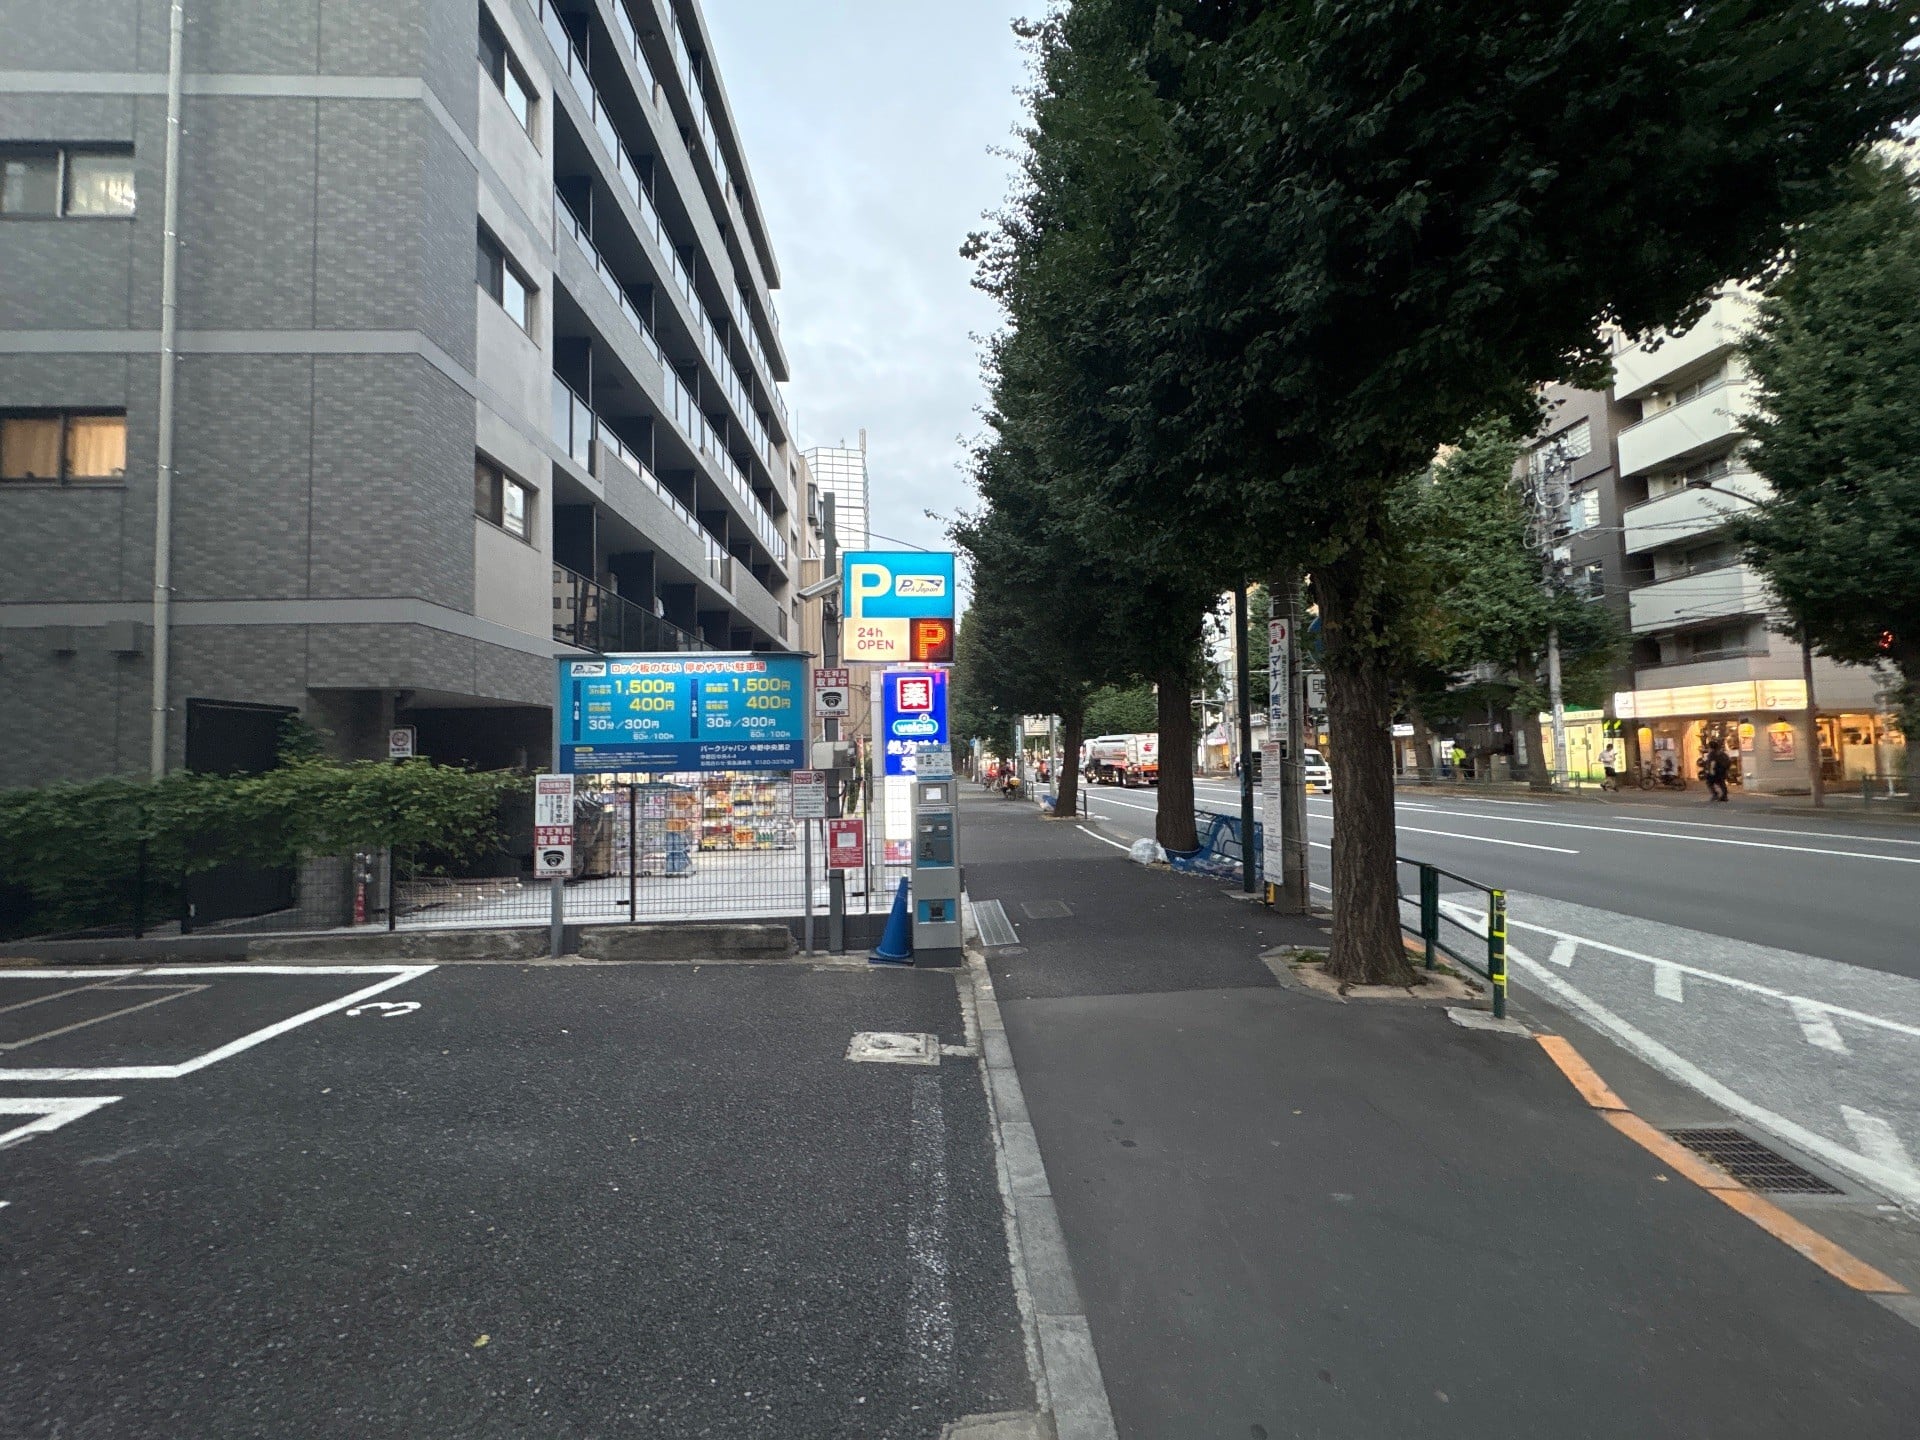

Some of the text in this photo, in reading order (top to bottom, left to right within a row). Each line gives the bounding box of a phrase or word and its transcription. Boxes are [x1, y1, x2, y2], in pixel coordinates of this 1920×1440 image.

[851, 563, 892, 618] P
[898, 579, 939, 594] Park Japan
[857, 627, 883, 638] 24h
[857, 640, 894, 650] OPEN
[919, 623, 947, 659] P
[611, 662, 766, 674] ロック板のない 停めやすい駐車場
[615, 679, 675, 695] 1,500円
[732, 678, 791, 693] 1,500円
[1270, 655, 1281, 720] マキノ質店
[902, 682, 928, 706] 薬
[629, 697, 675, 711] 400円
[746, 695, 791, 709] 400円
[896, 721, 934, 733] welcia
